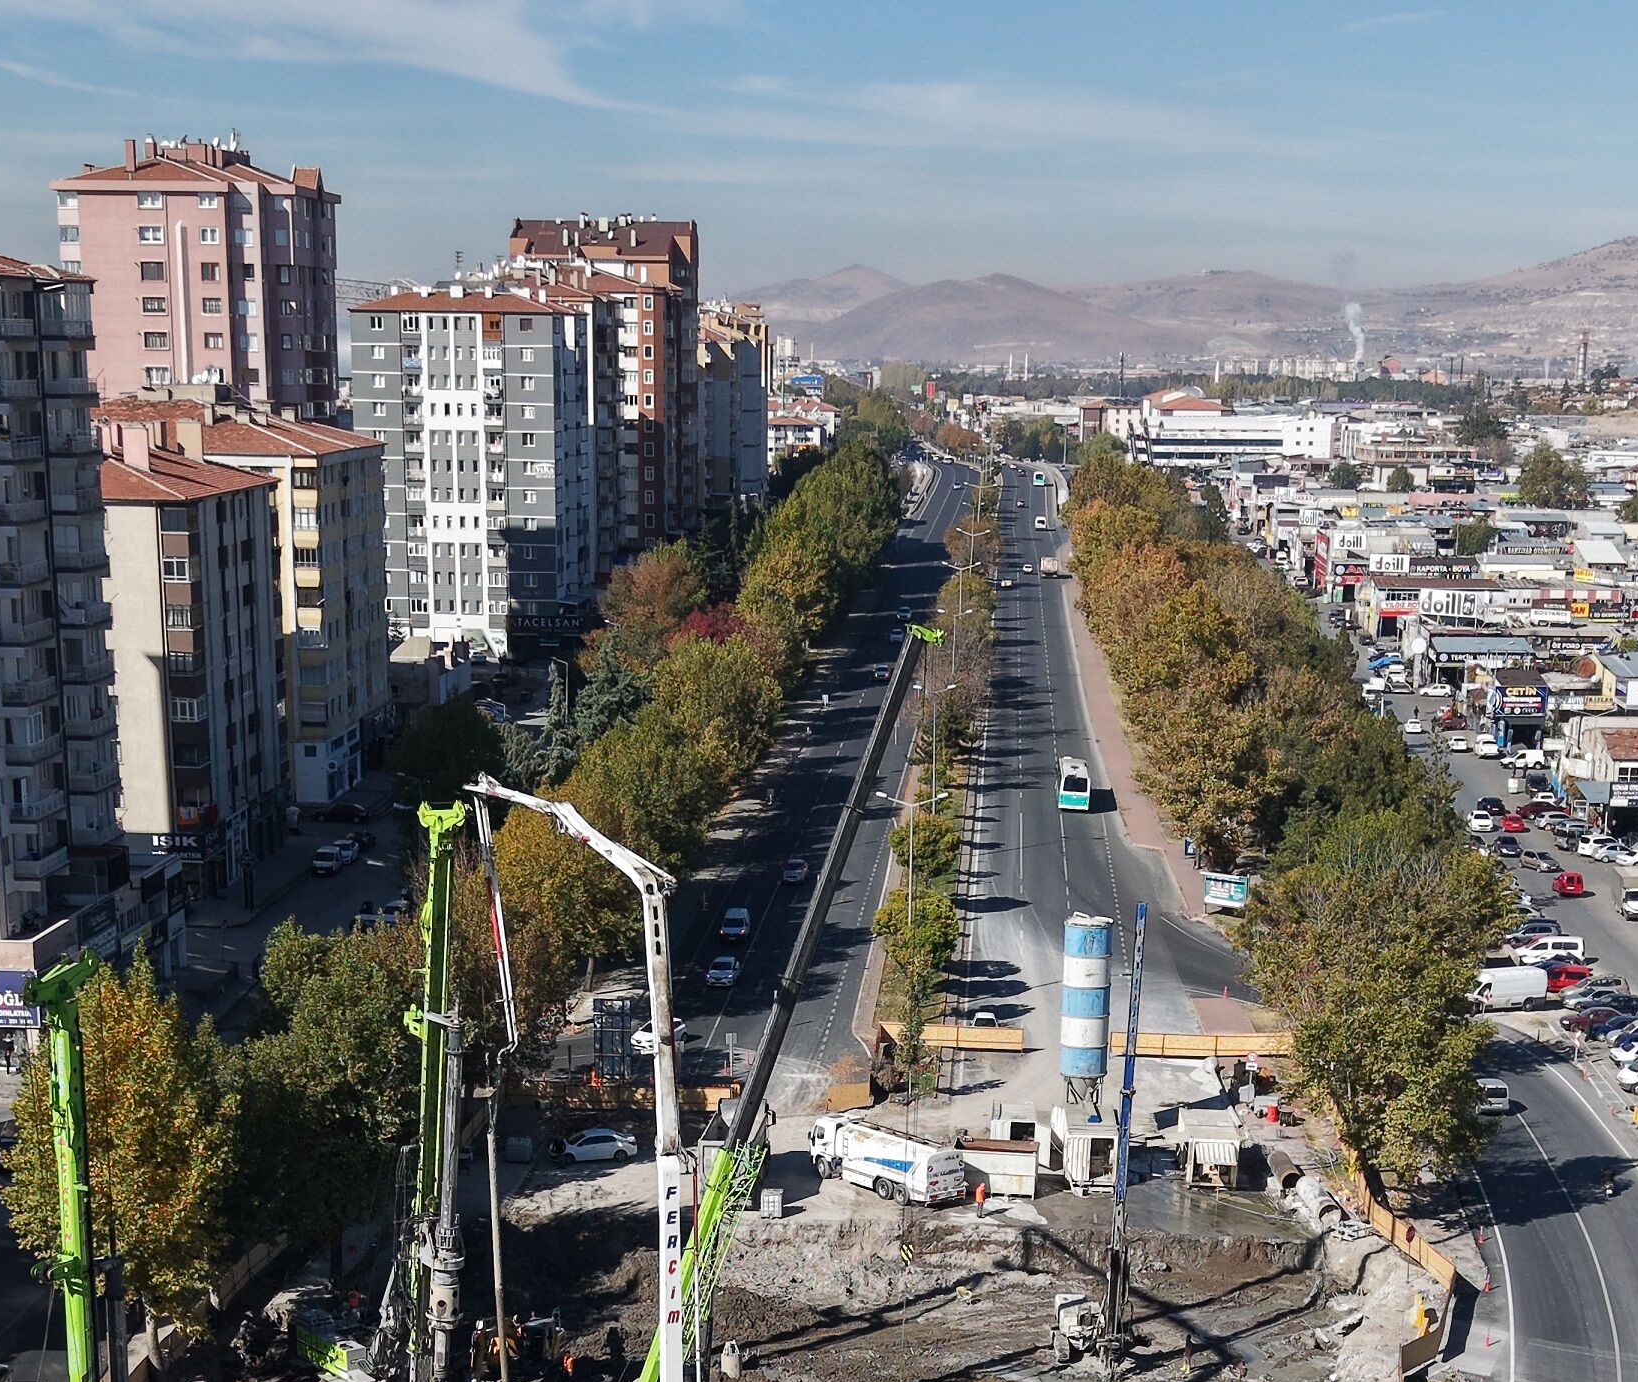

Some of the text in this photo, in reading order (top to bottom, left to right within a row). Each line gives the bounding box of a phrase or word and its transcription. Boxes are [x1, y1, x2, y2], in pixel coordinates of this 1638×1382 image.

[1339, 534, 1362, 549] doill
[1375, 557, 1403, 571] doill
[1420, 590, 1463, 615] doill
